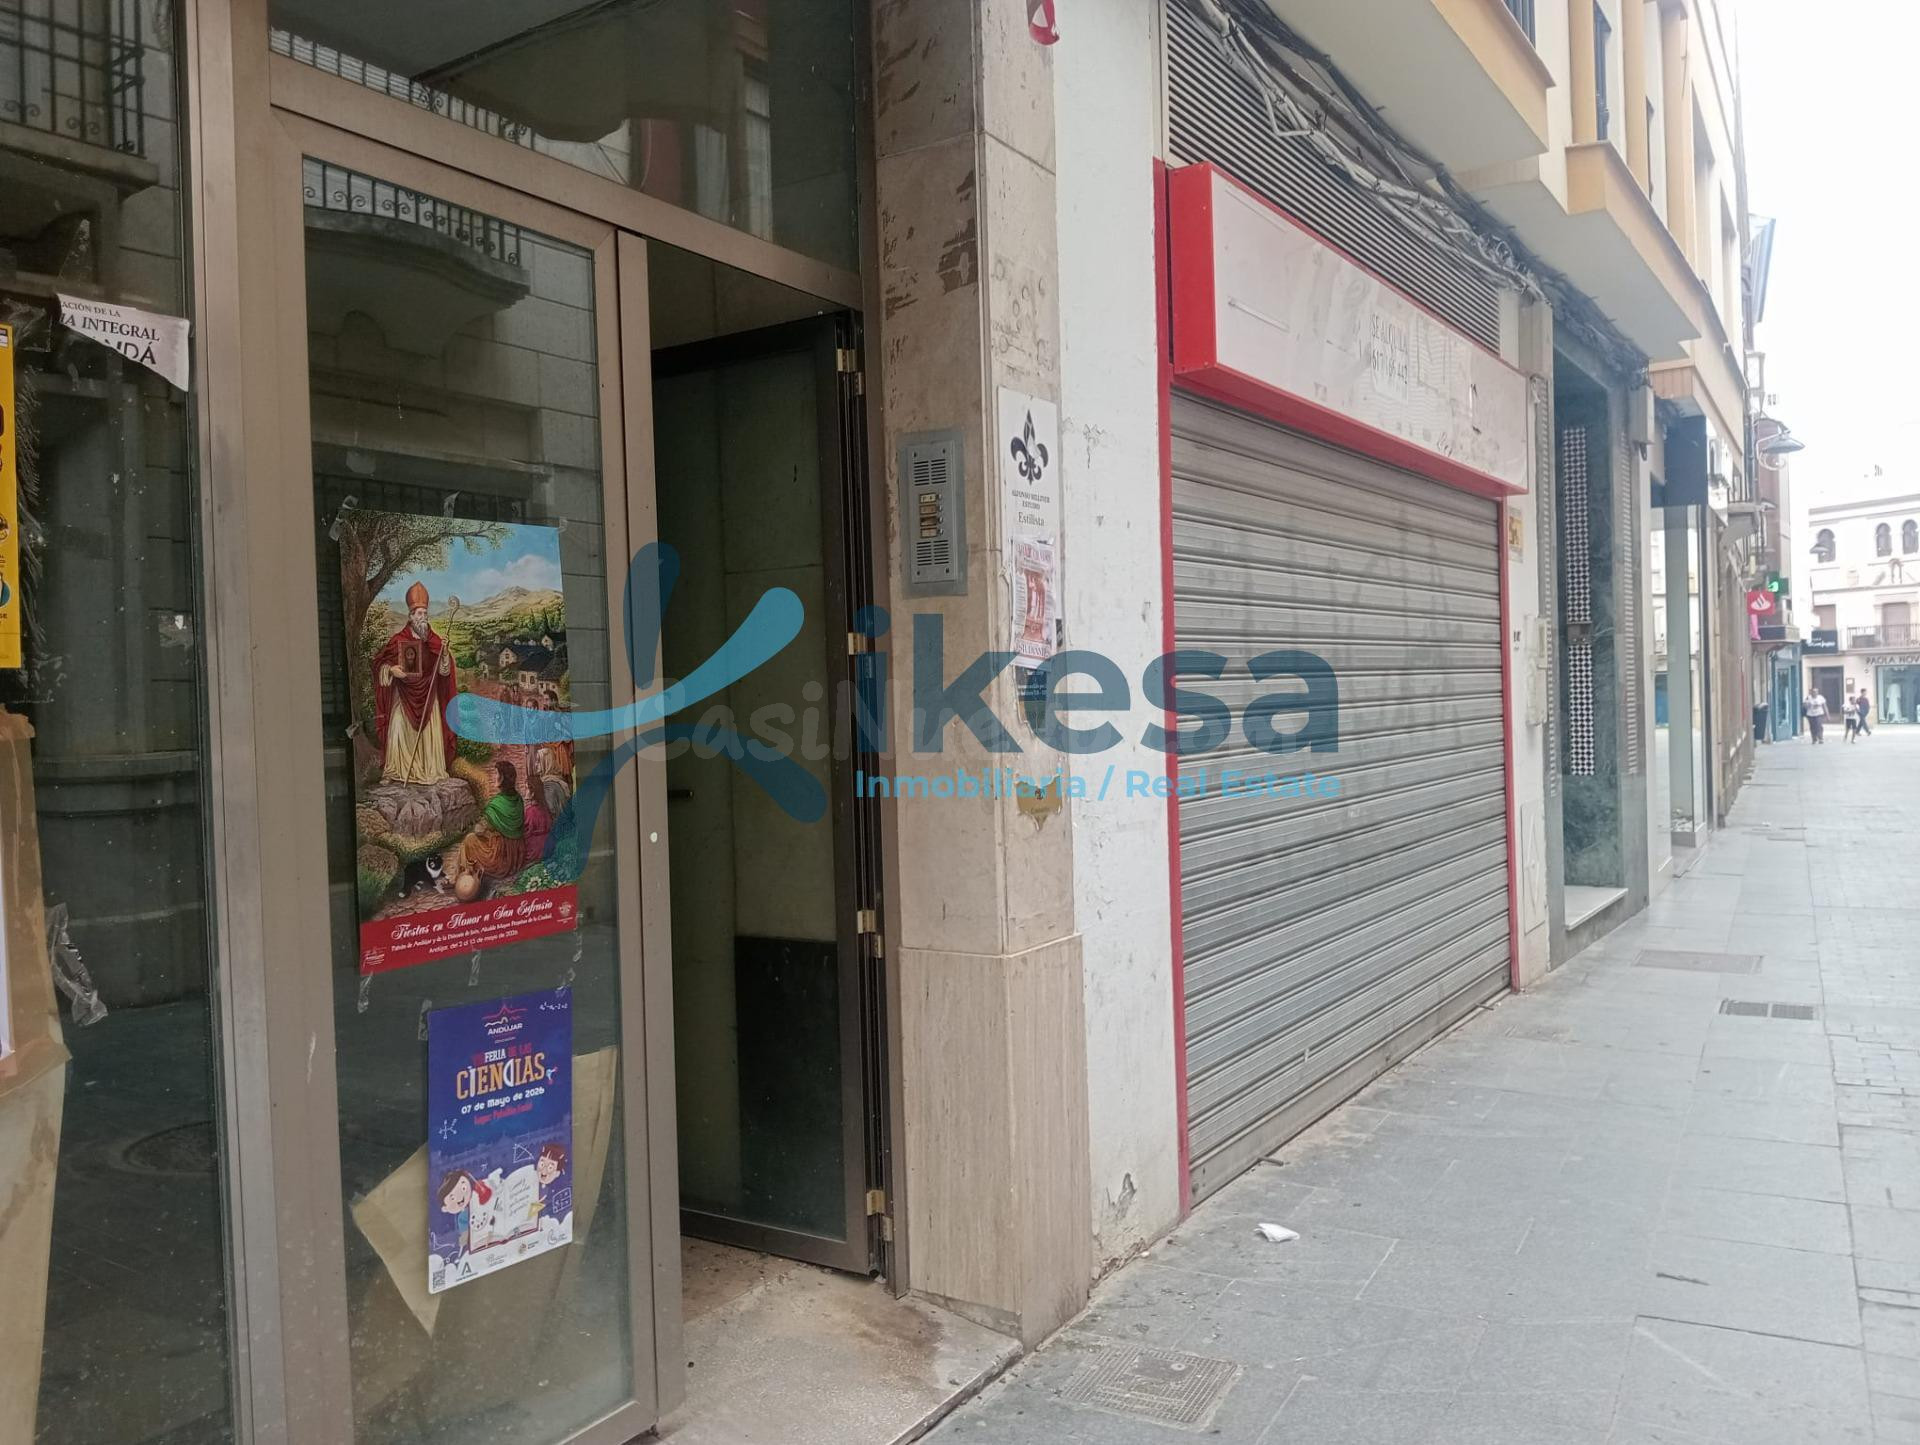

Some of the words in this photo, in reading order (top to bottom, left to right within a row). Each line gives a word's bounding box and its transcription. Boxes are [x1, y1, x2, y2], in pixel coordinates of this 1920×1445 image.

[94, 307, 107, 315] DE
[109, 309, 120, 318] LA
[82, 317, 160, 342] INTEGRAL
[391, 922, 430, 940] Fiestas
[433, 923, 443, 932] en
[447, 911, 480, 929] Honor
[493, 904, 514, 920] San
[517, 897, 553, 918] Eufrasio
[485, 1048, 506, 1063] FERIA
[456, 1052, 545, 1100] CIENCIAS
[461, 1105, 472, 1115] 07
[474, 1100, 485, 1111] de
[513, 1092, 523, 1101] de
[525, 1086, 545, 1098] 2026
